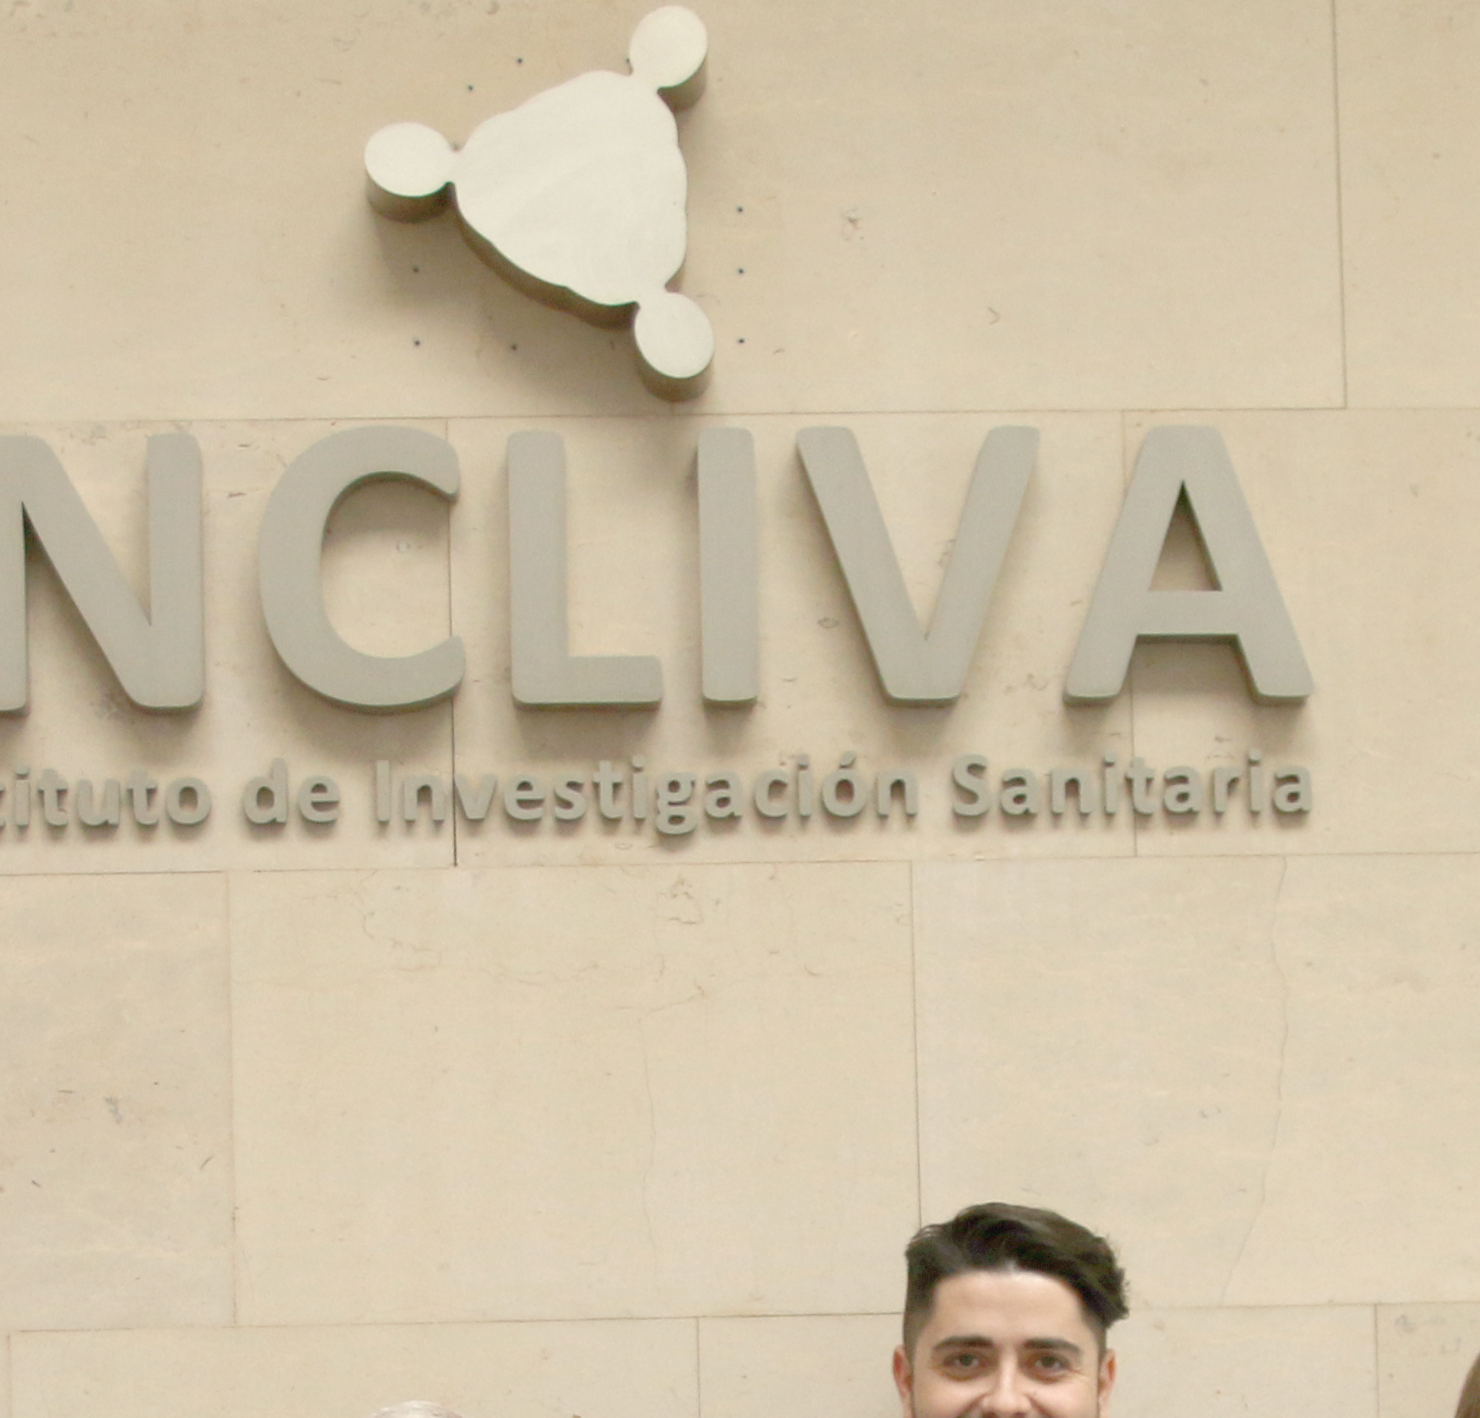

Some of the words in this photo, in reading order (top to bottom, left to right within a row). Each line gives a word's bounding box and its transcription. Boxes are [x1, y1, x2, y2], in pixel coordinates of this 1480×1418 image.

[242, 757, 341, 826] de
[374, 749, 918, 836] Investigación
[950, 748, 1312, 820] Sanitaria
